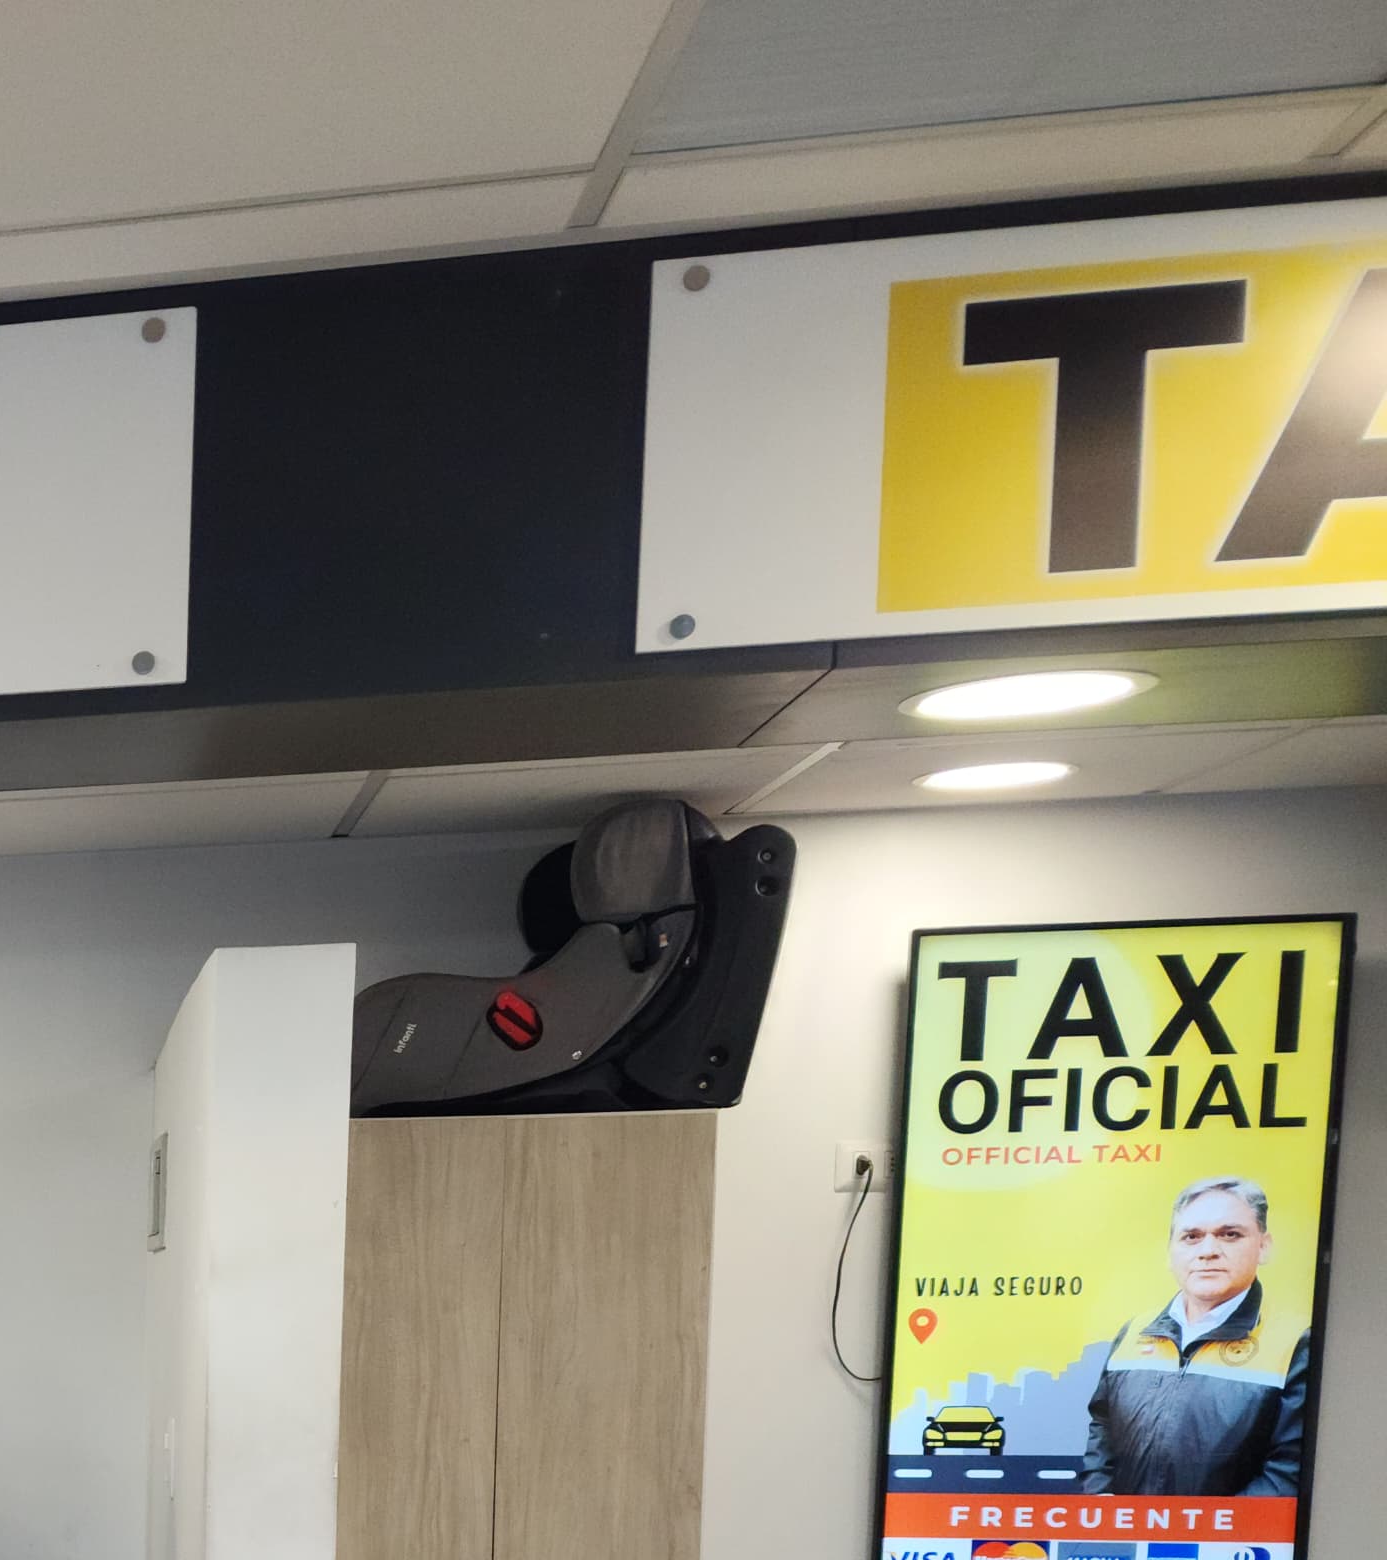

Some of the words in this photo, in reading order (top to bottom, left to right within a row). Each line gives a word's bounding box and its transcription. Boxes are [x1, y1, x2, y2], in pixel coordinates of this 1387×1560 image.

[937, 949, 1306, 1062] TAXI
[938, 1062, 1308, 1135] OFICIAL
[941, 1145, 1082, 1166] OFFICIAL
[1093, 1143, 1162, 1163] TAXI
[915, 1276, 980, 1298] VIAJA
[993, 1275, 1083, 1297] SEGURO
[949, 1505, 1236, 1531] FRECUENTE
